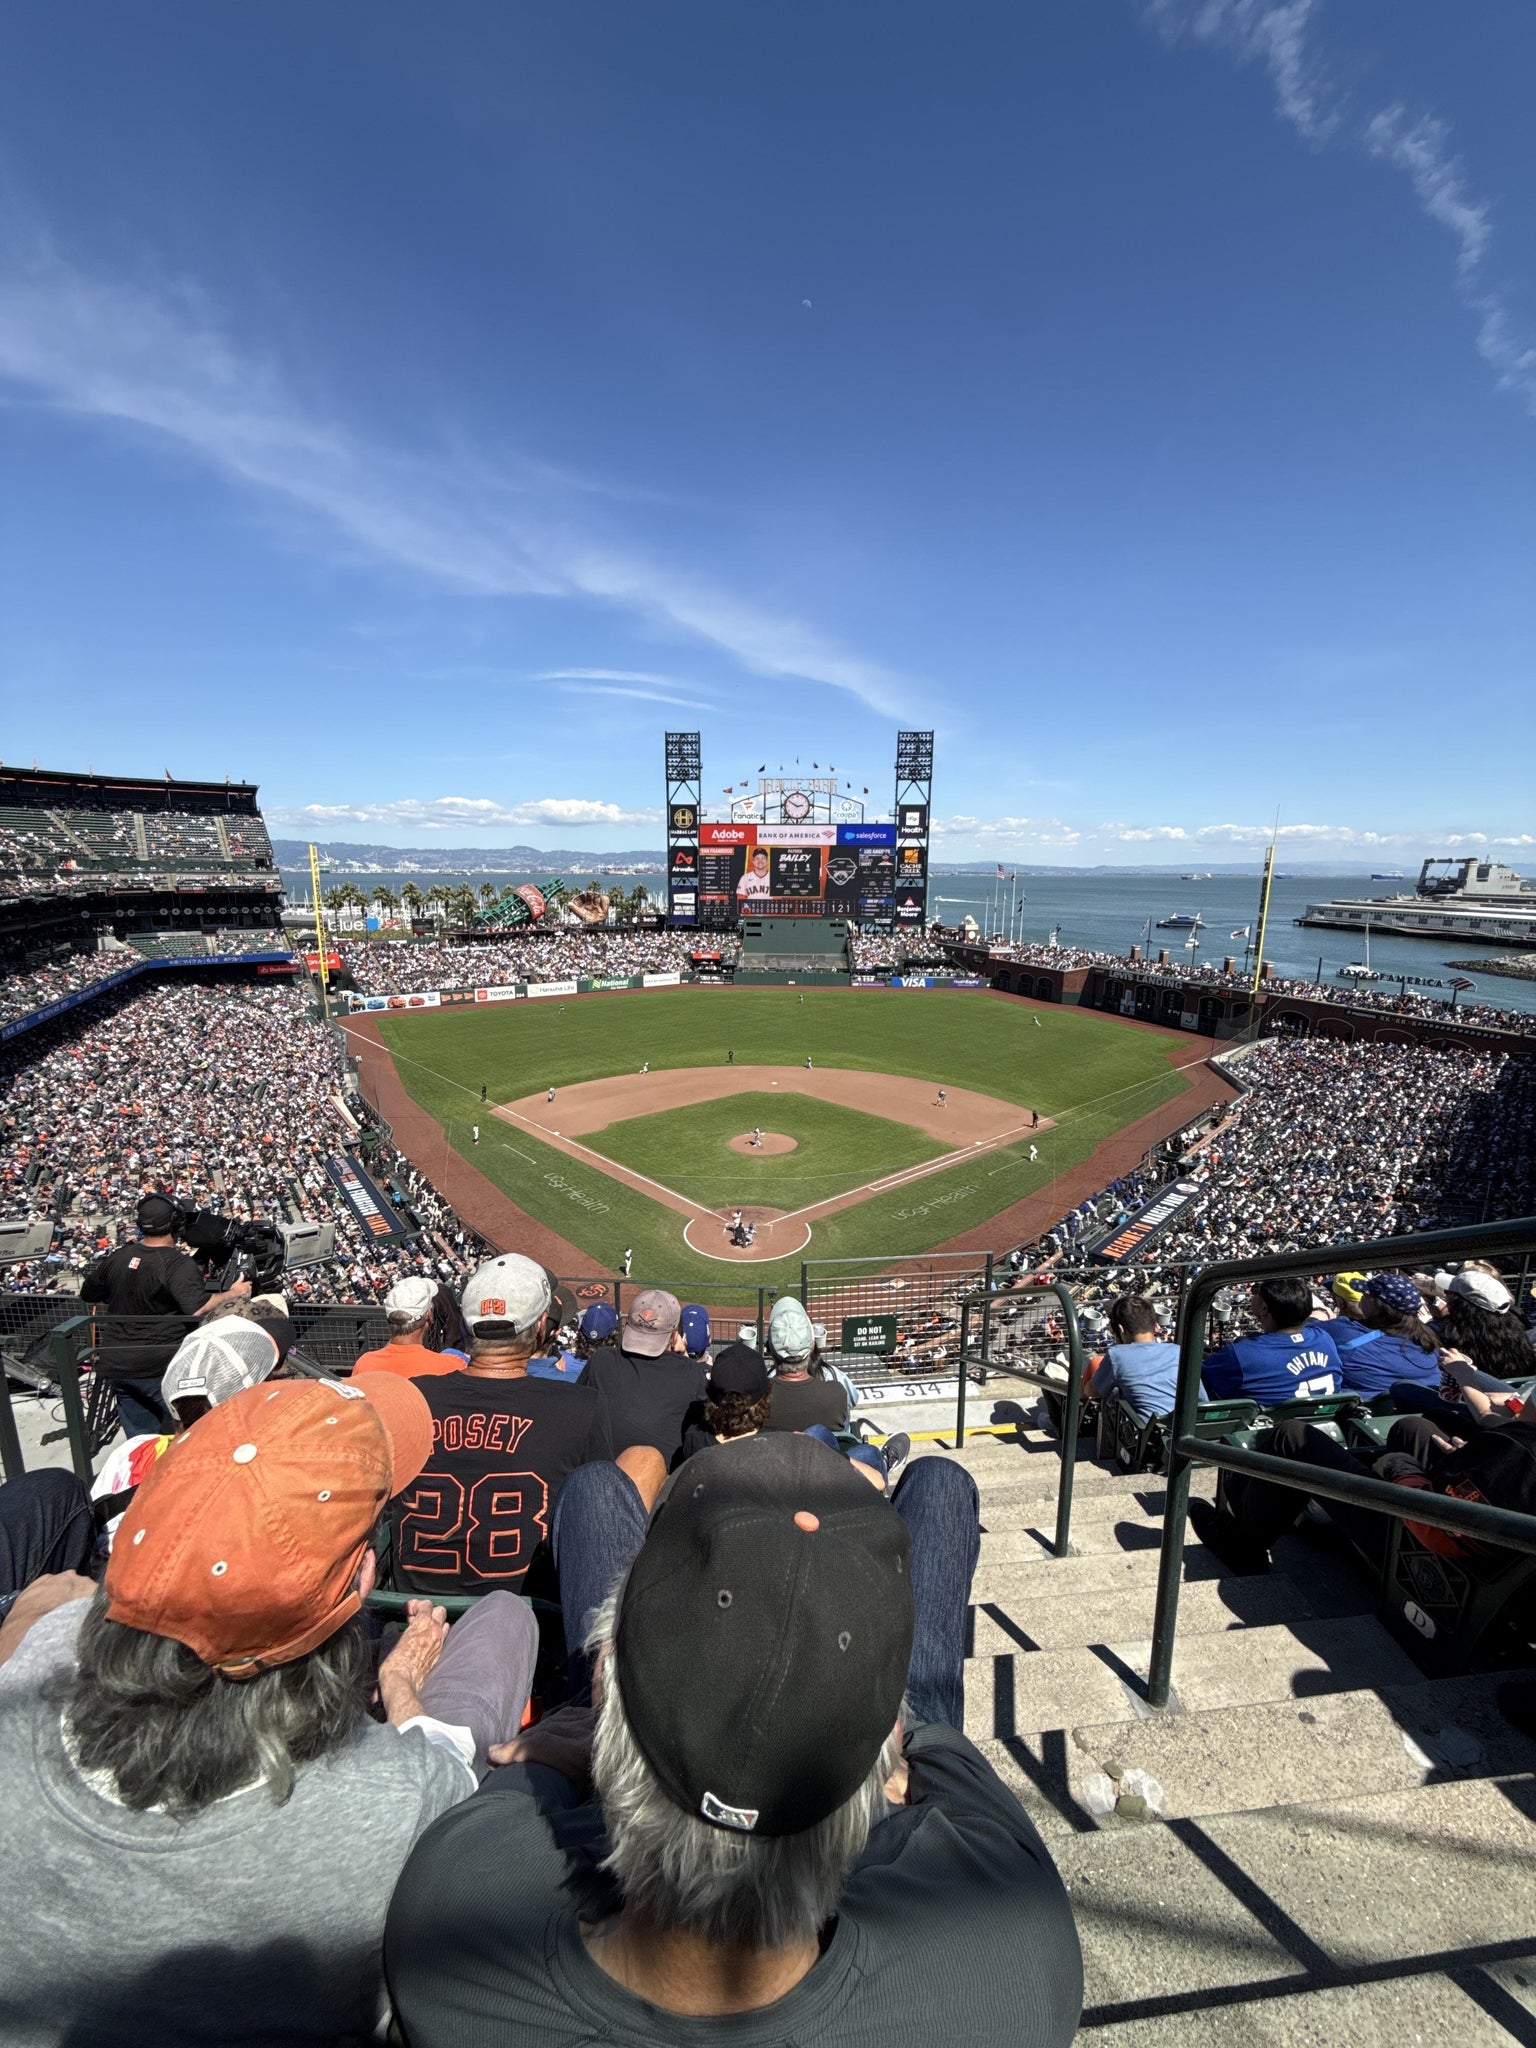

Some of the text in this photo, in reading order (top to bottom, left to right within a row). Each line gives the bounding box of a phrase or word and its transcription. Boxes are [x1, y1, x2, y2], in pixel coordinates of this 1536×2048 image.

[733, 811, 763, 820] Fanatics
[711, 830, 745, 839] Adobe
[856, 832, 887, 840] salesforce
[779, 854, 812, 862] BAILEY
[838, 904, 844, 912] 2
[328, 918, 363, 932] blue
[601, 979, 629, 987] National
[900, 977, 926, 988] VISA
[1137, 975, 1183, 989] LANDING
[1388, 974, 1443, 987] AMERICA
[560, 1186, 609, 1215] Health
[923, 1184, 983, 1209] Health
[857, 1326, 883, 1336] DO NOT
[1286, 1351, 1329, 1376] OHTANI
[904, 1383, 941, 1396] 314
[430, 1413, 533, 1455] POSEY
[399, 1471, 548, 1578] 28
[1412, 1608, 1427, 1628] D
